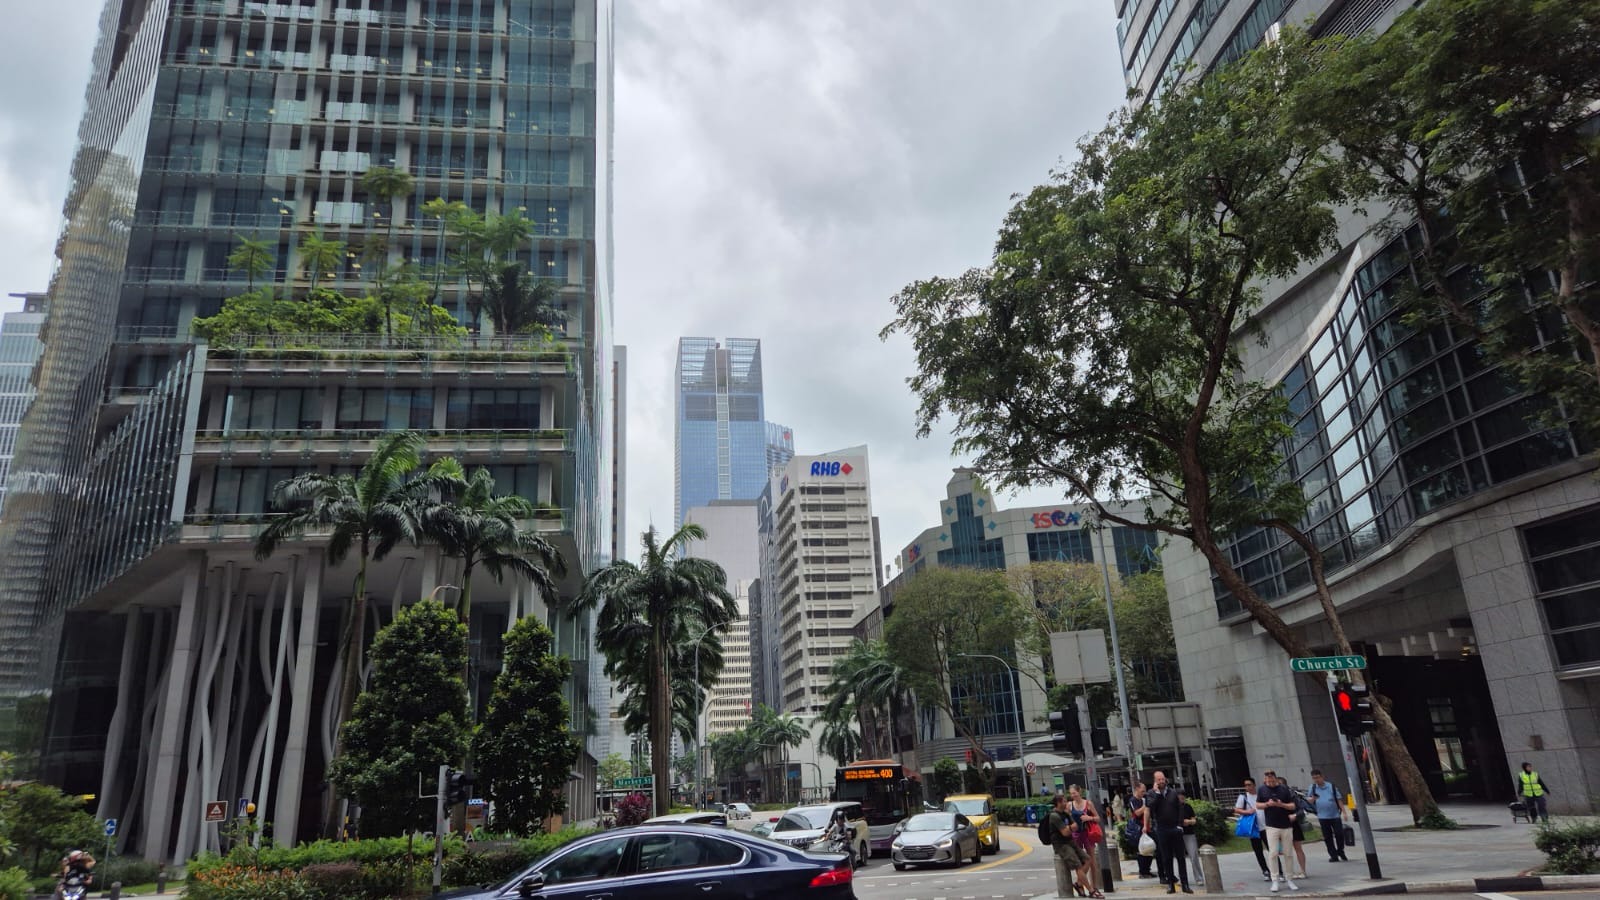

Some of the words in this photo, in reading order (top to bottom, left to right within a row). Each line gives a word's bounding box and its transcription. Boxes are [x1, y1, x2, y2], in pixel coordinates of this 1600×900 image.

[810, 461, 841, 477] RHB
[1297, 658, 1343, 670] Church
[1346, 657, 1360, 668] St
[880, 768, 893, 779] 400
